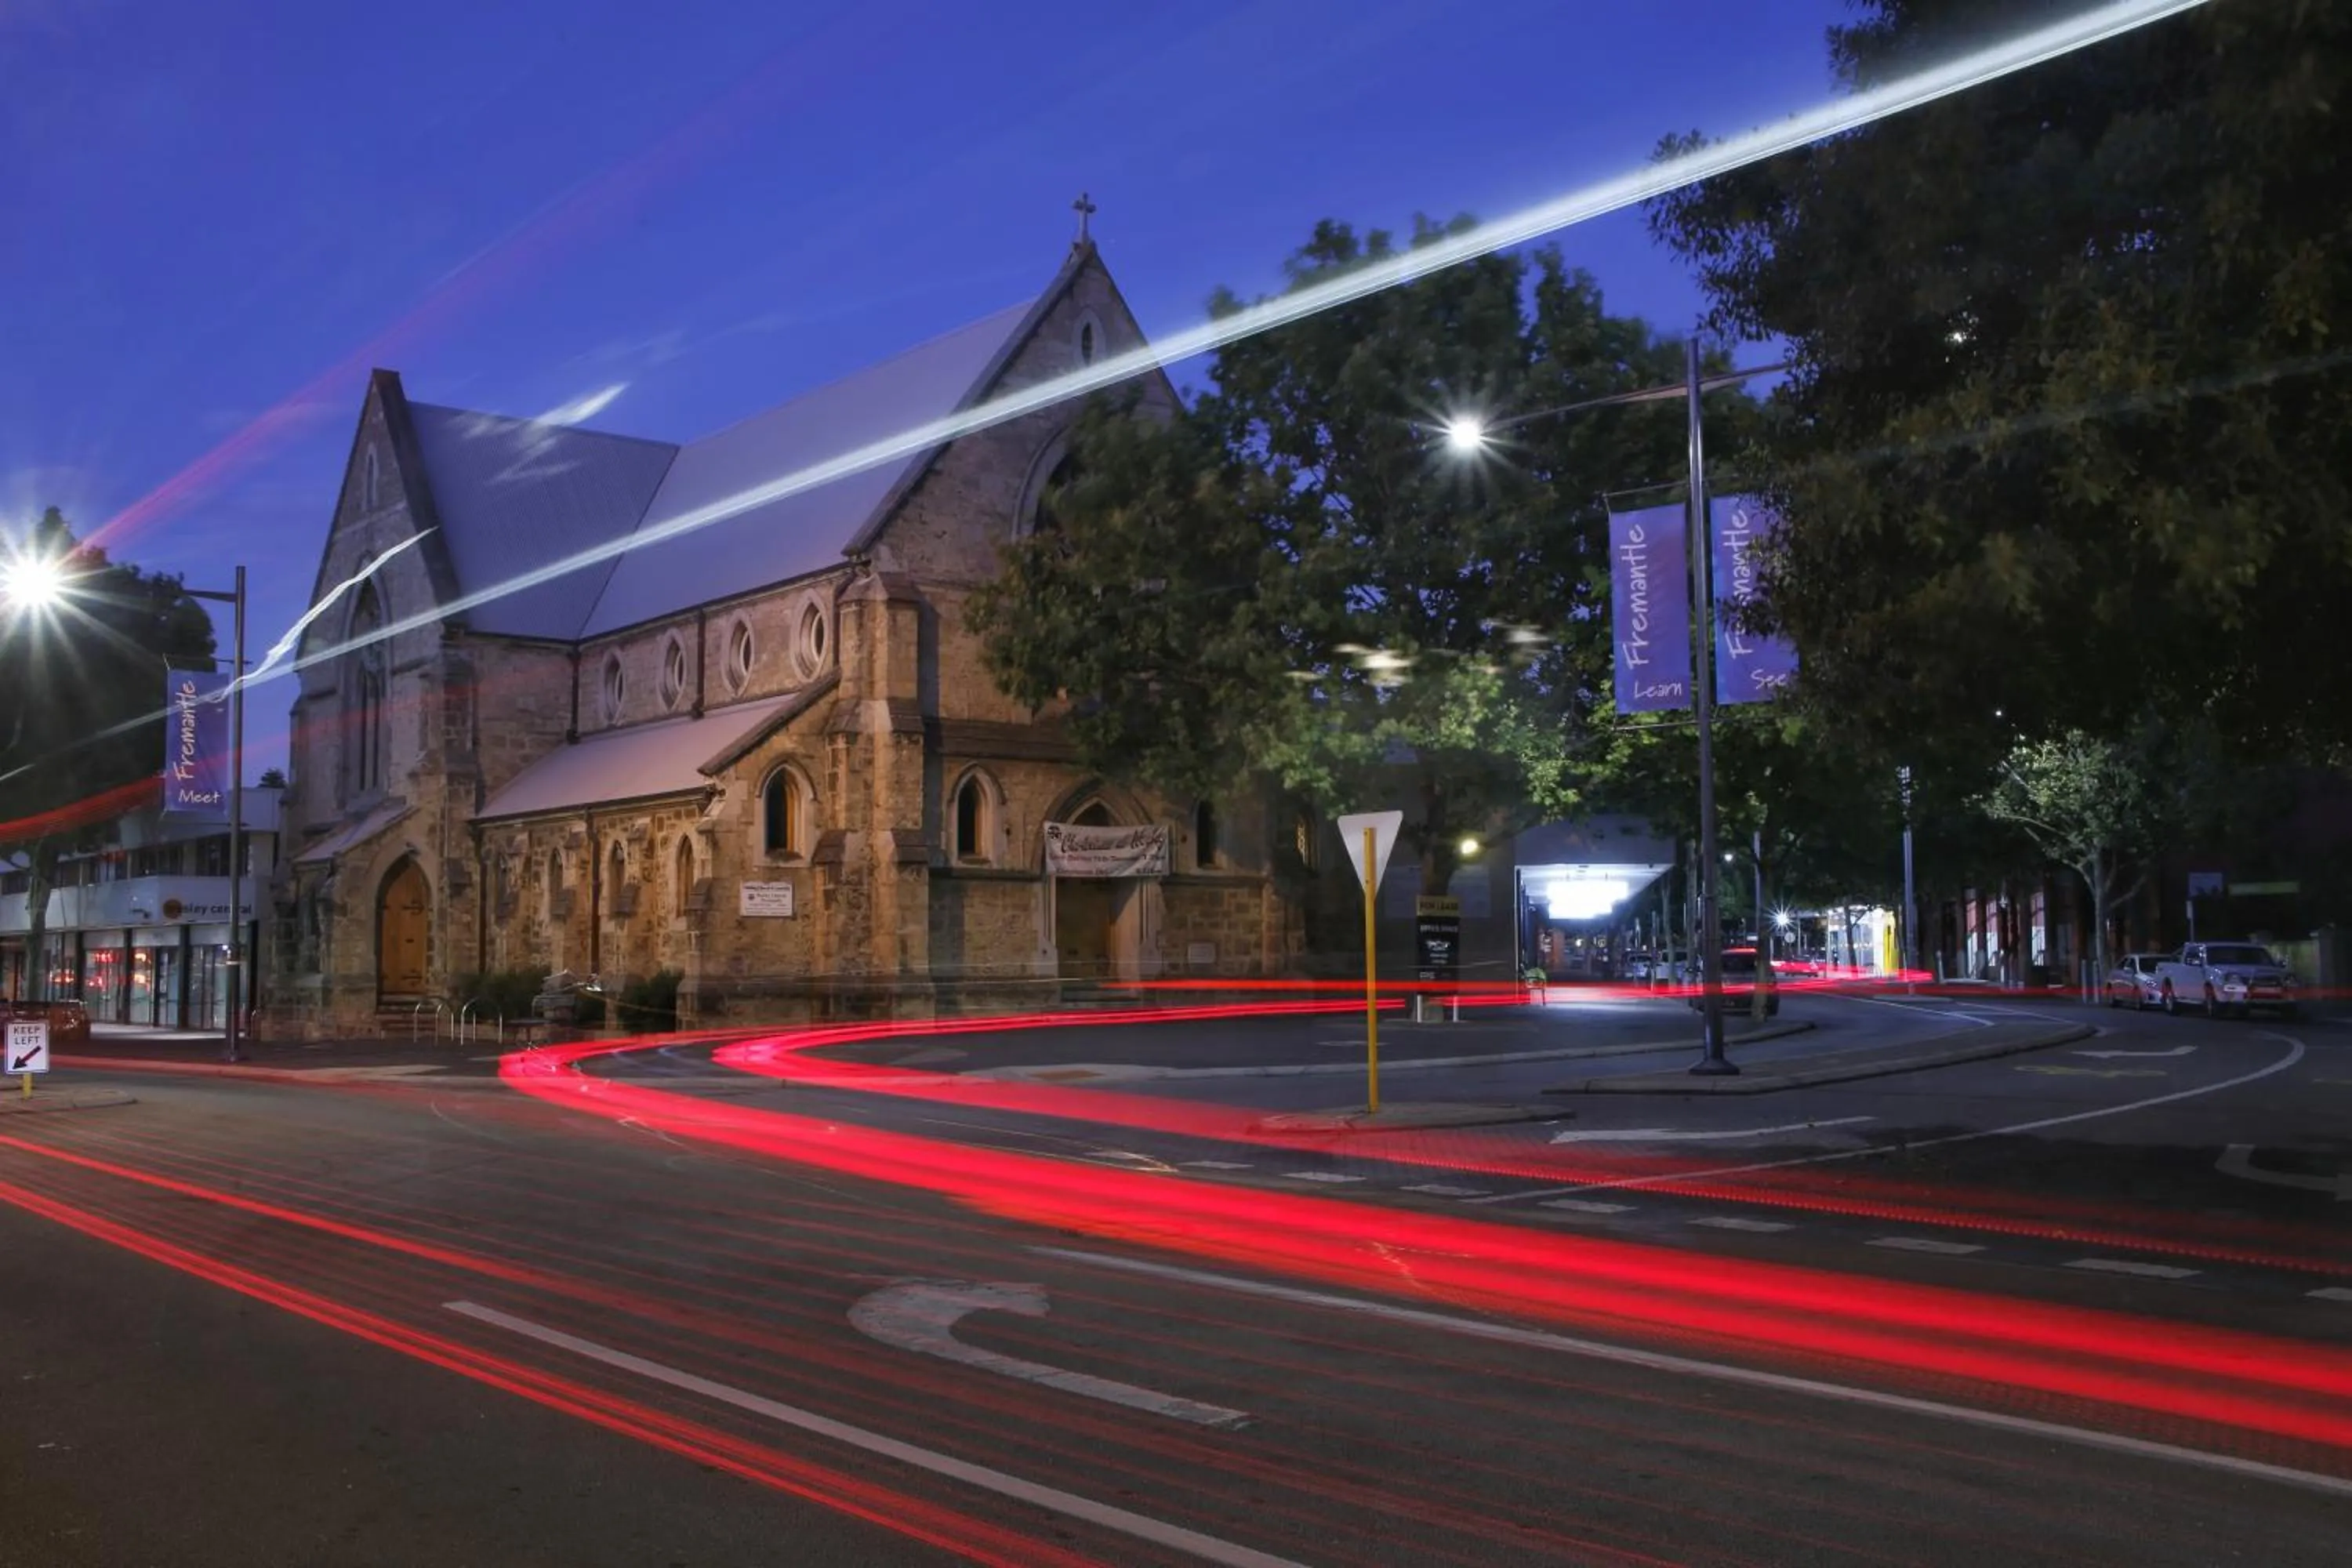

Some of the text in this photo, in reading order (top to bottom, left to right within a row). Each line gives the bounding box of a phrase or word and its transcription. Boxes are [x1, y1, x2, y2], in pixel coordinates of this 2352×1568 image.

[1722, 510, 1754, 659] Fmantle
[1620, 523, 1649, 670] Fremantle
[1751, 669, 1787, 689] See
[1635, 681, 1682, 699] Learn
[172, 680, 196, 781] Fremantle
[178, 789, 221, 804] Meet
[210, 903, 252, 914] cenral
[13, 1025, 41, 1034] KEEP
[14, 1036, 41, 1045] LEFT
